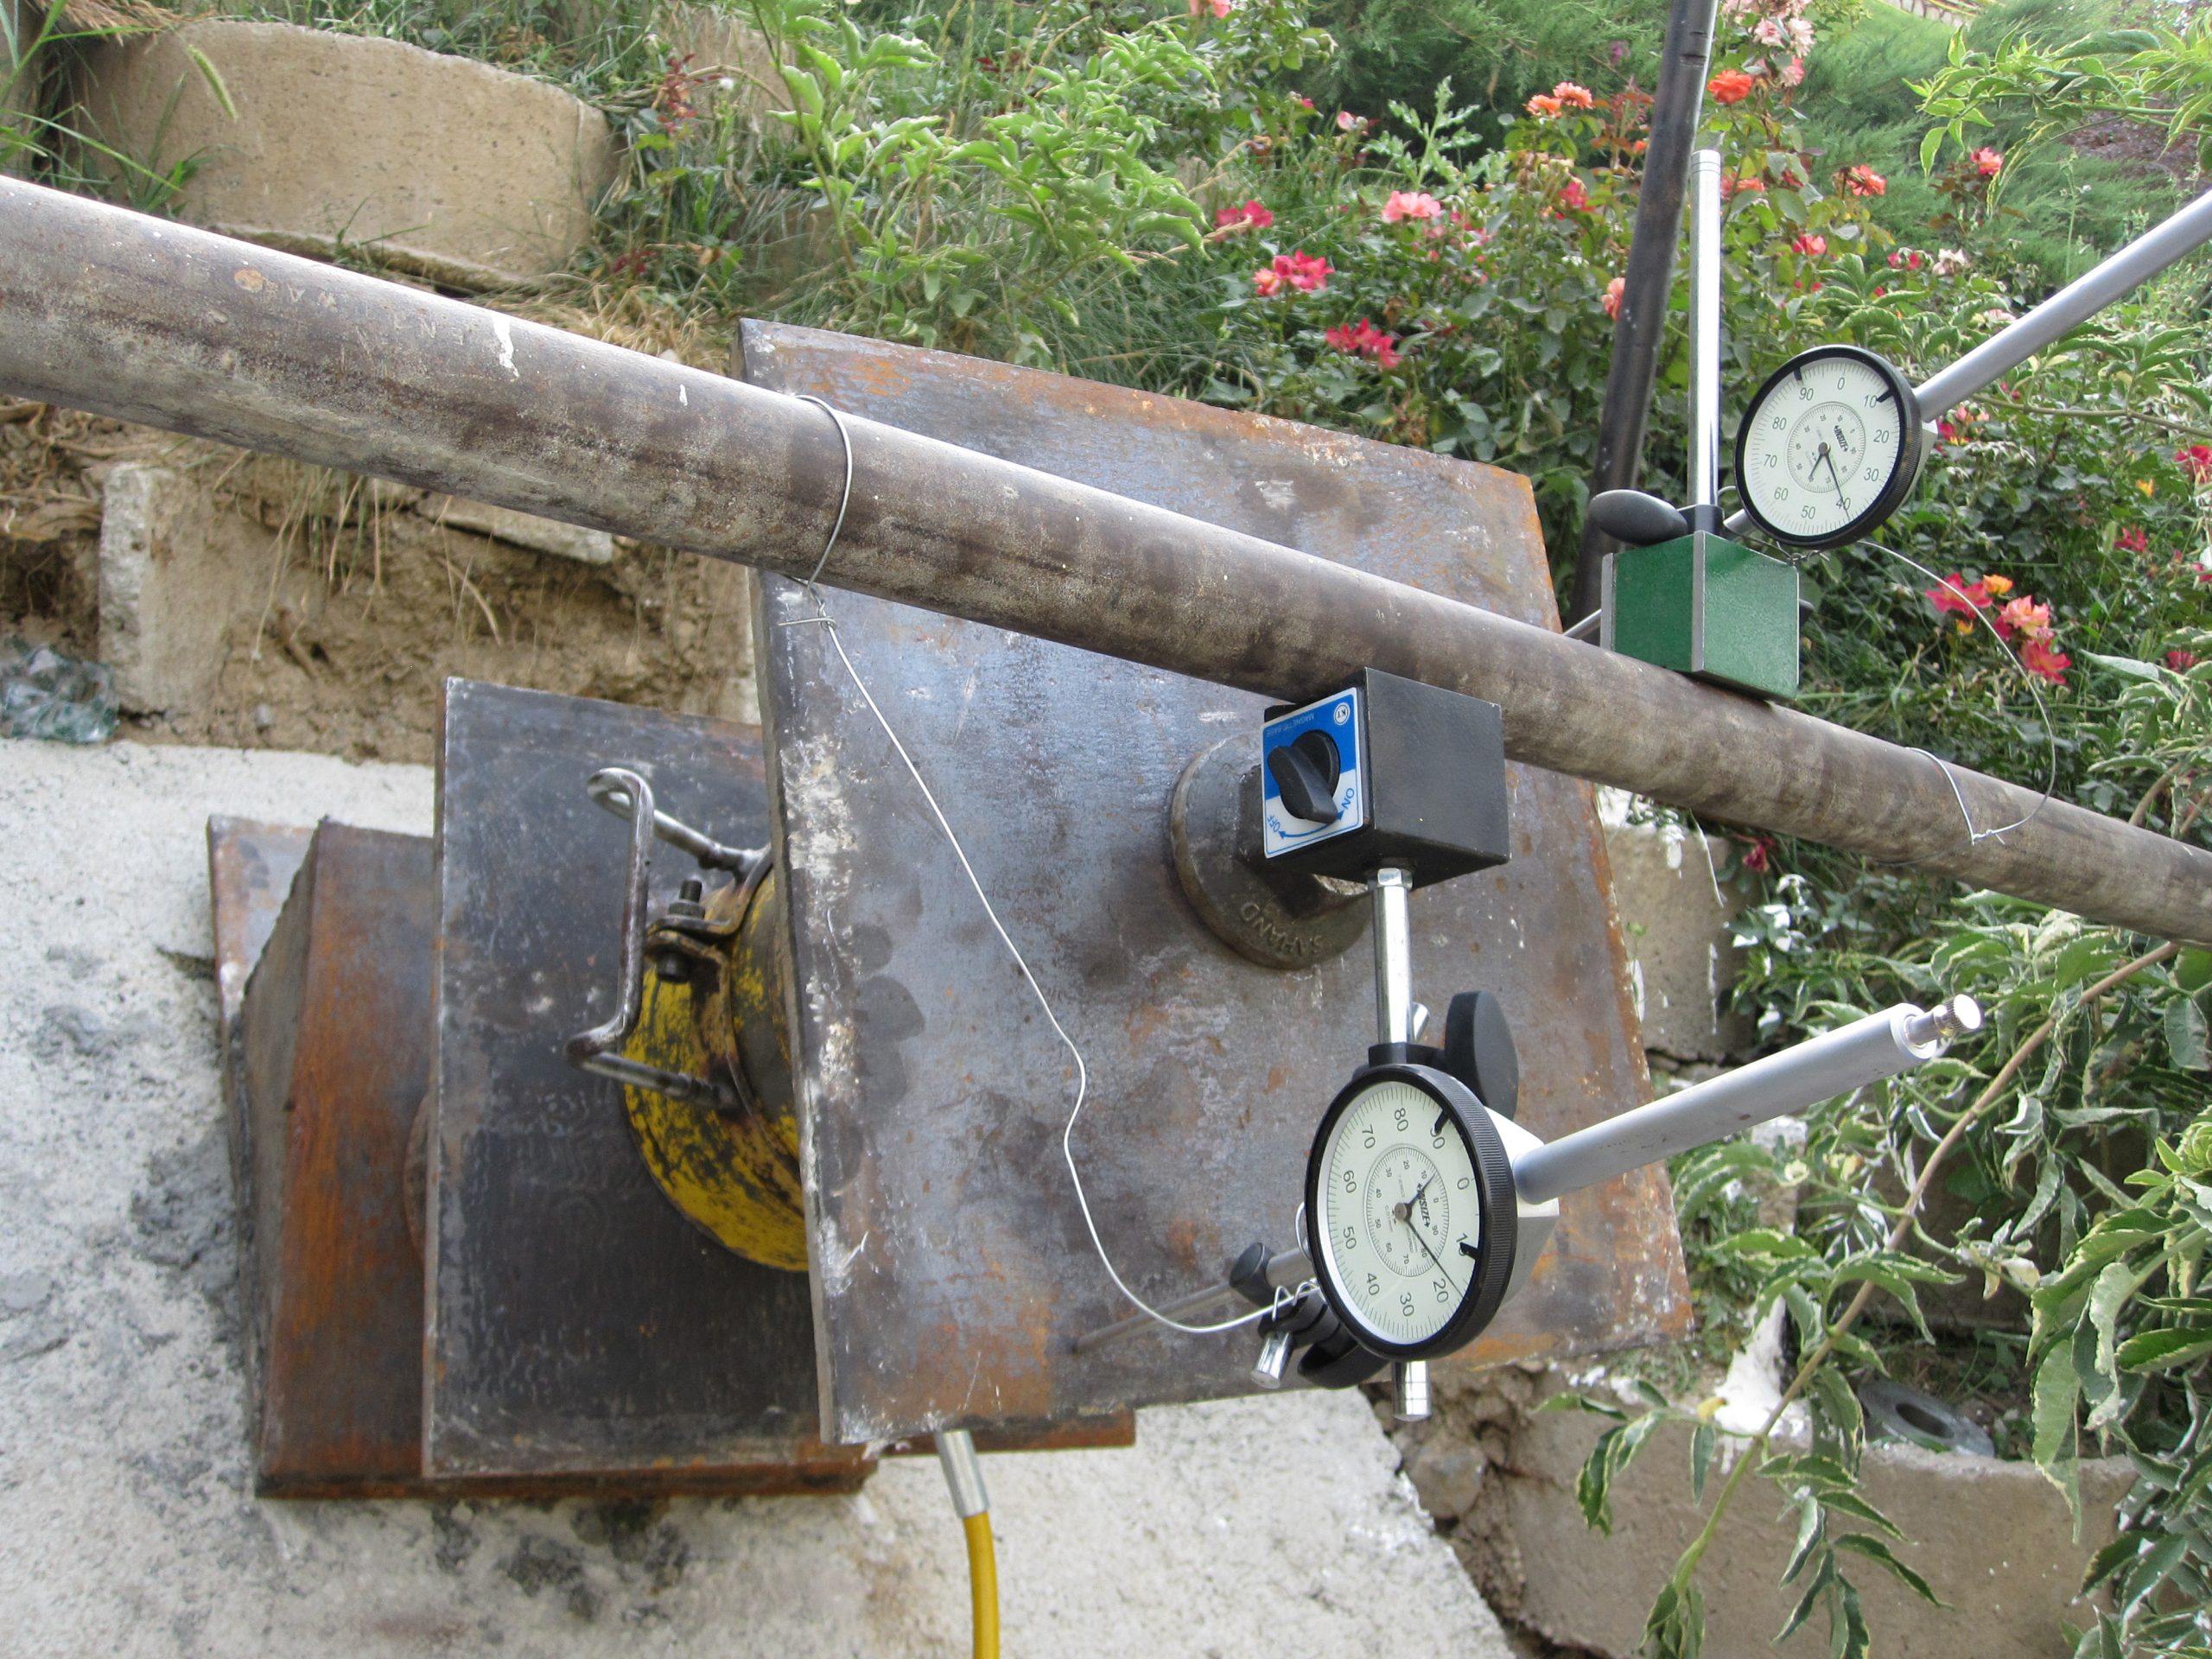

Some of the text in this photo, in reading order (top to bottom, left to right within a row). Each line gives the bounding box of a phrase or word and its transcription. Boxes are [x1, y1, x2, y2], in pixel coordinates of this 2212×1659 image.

[1837, 377, 1845, 390] 0
[1799, 388, 1814, 401] 90
[1865, 394, 1877, 408] 10
[1772, 417, 1786, 429] 80
[1873, 430, 1890, 443] 20
[1764, 454, 1777, 467] 70
[1864, 468, 1878, 481] 30
[1775, 487, 1789, 500] 60
[1836, 498, 1851, 511] 40
[1801, 506, 1815, 519] 50
[1337, 709, 1347, 718] KT
[1286, 713, 1314, 731] MAGNETIC
[1343, 788, 1355, 809] ON
[1268, 815, 1281, 832] OFF
[1241, 901, 1322, 957] SAHAND
[1395, 1108, 1408, 1132] 80
[1362, 1125, 1376, 1149] 70
[1403, 1160, 1410, 1170] 20
[1386, 1167, 1392, 1178] 30
[1421, 1170, 1427, 1179] 10
[1343, 1170, 1357, 1193] 60
[1457, 1177, 1469, 1191] 0
[1376, 1189, 1382, 1198] 40
[1417, 1192, 1430, 1223] SIZE
[1375, 1218, 1381, 1229] 50
[1432, 1225, 1439, 1236] 90
[1343, 1228, 1357, 1249] 50
[1403, 1254, 1409, 1264] 70
[1367, 1273, 1380, 1296] 40
[1433, 1278, 1448, 1303] 20
[1400, 1292, 1414, 1317] 30
